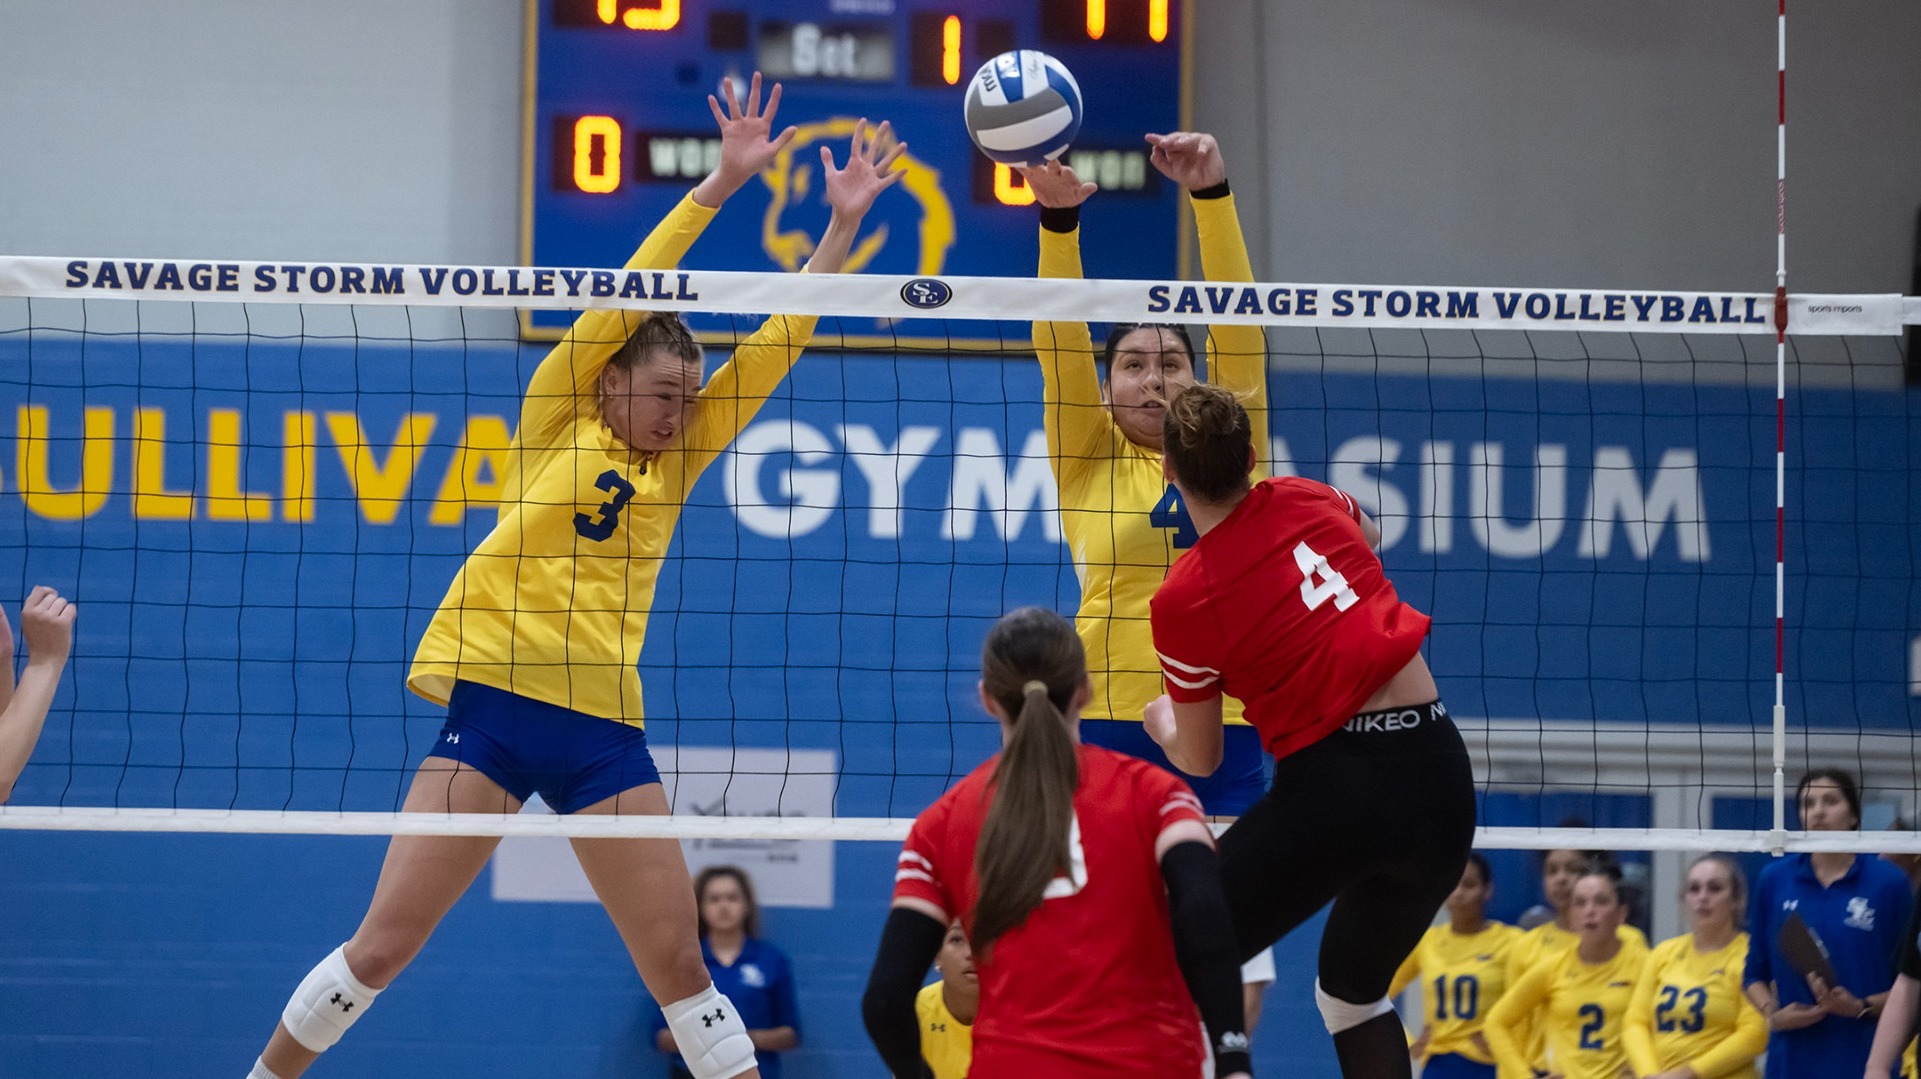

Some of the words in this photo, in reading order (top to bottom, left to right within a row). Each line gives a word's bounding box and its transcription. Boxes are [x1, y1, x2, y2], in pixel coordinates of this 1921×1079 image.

[792, 23, 855, 76] Set
[943, 15, 961, 85] 1
[574, 115, 621, 193] 0
[66, 261, 240, 292] SAVAGE
[254, 265, 405, 295] STORM
[418, 267, 698, 301] VOLLEYBALL
[1148, 286, 1317, 316] SAVAGE
[1332, 290, 1479, 319] STORM
[1493, 292, 1765, 324] VOLLEYBALL
[0, 405, 514, 526] ULLIVA
[573, 469, 636, 542] 3
[1150, 483, 1200, 549] 4
[1293, 541, 1360, 613] 4
[1435, 974, 1478, 1020] 10
[1578, 1003, 1604, 1050] 2
[1656, 985, 1708, 1033] 23
